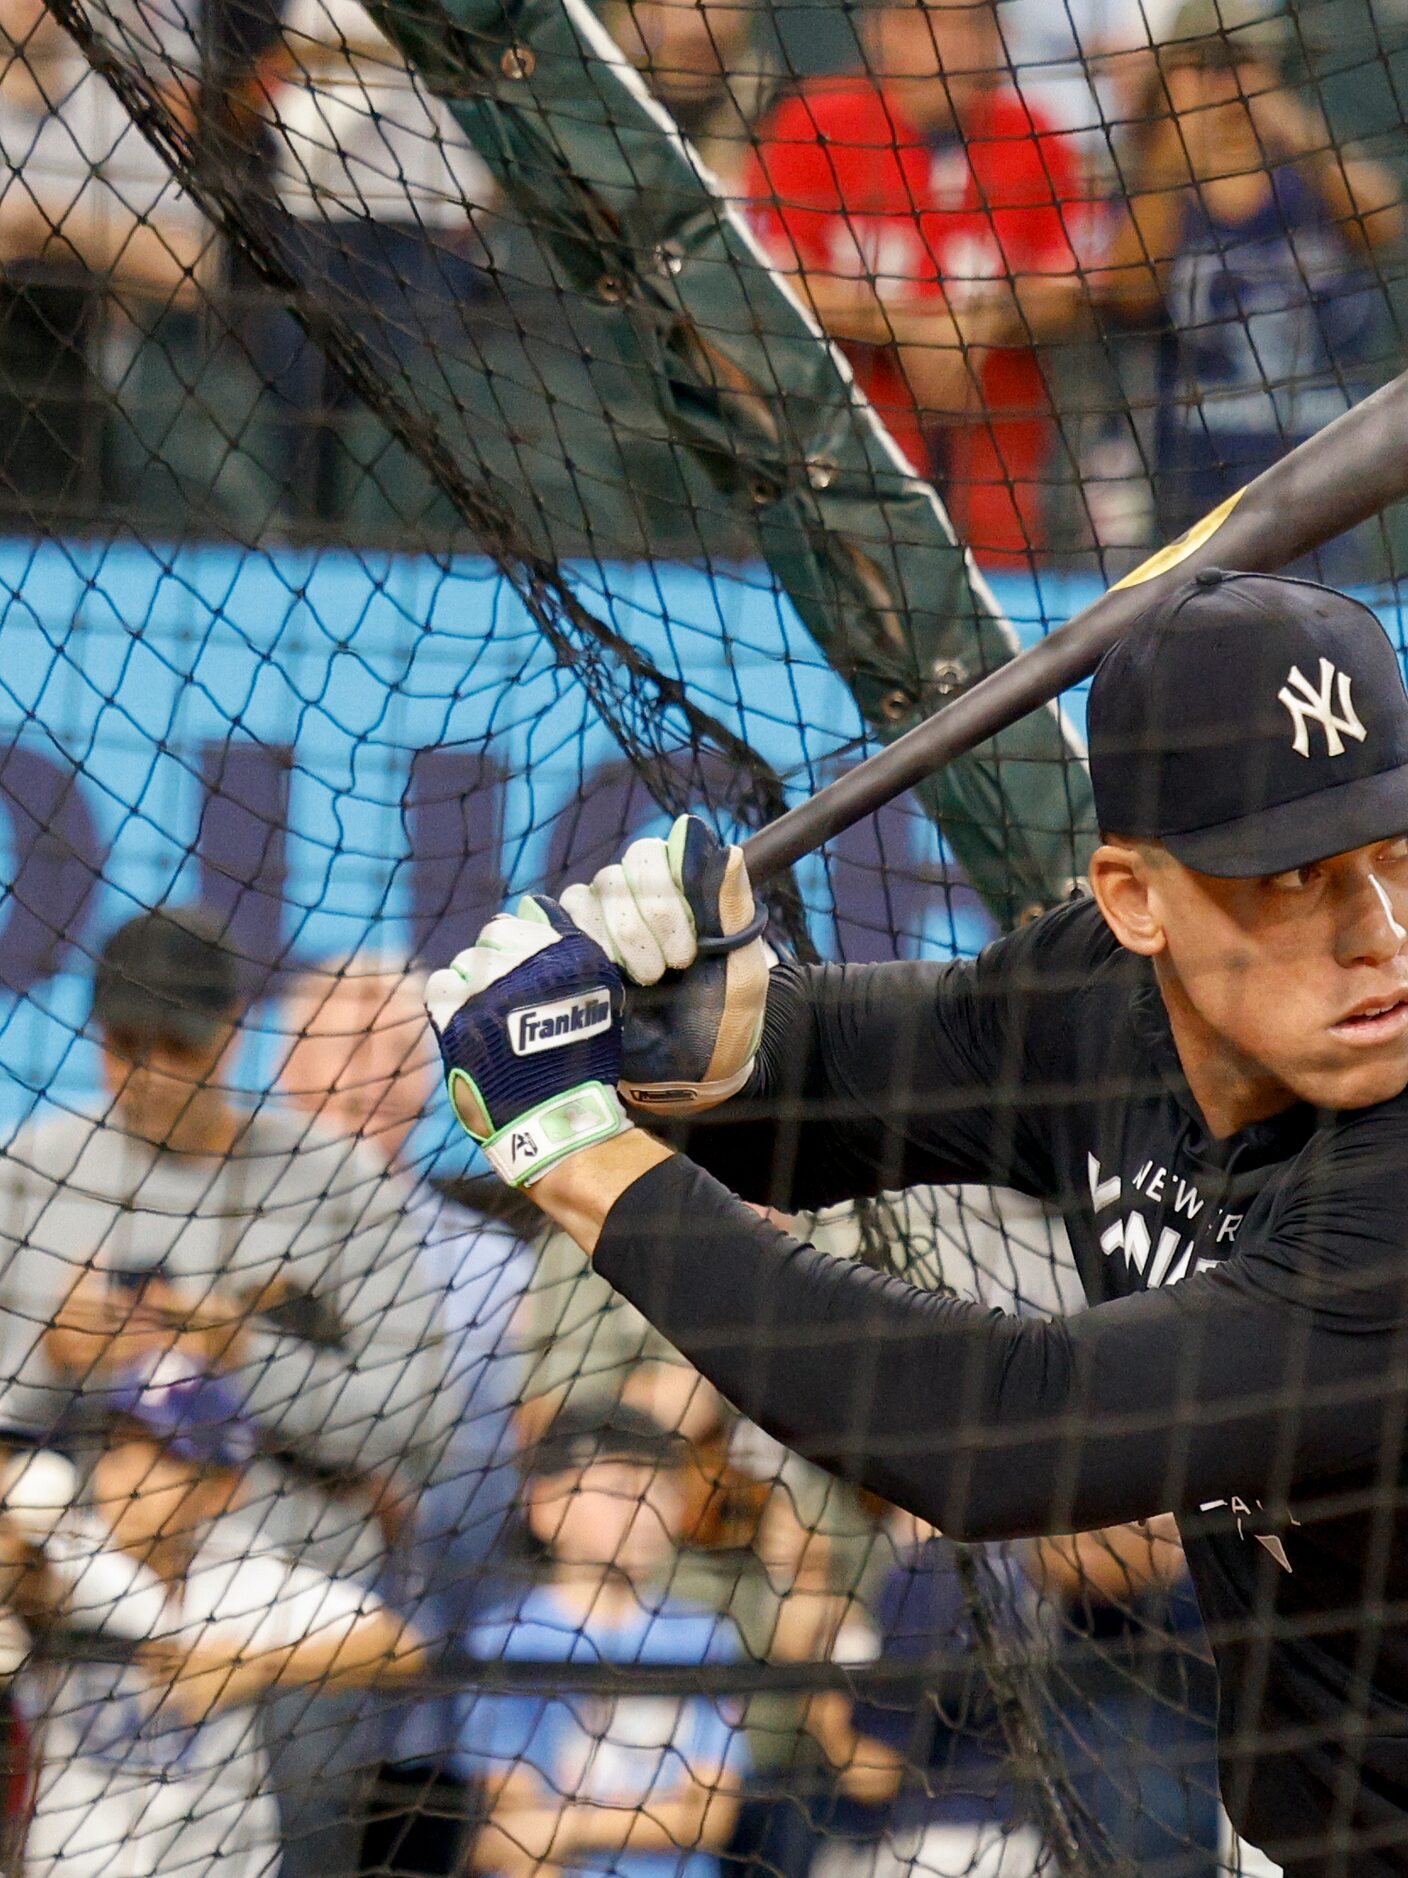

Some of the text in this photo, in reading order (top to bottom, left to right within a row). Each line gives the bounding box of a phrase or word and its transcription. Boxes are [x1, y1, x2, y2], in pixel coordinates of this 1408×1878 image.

[1277, 656, 1368, 759] NY
[518, 1001, 610, 1051] Franklin
[1131, 1159, 1205, 1220] NEW
